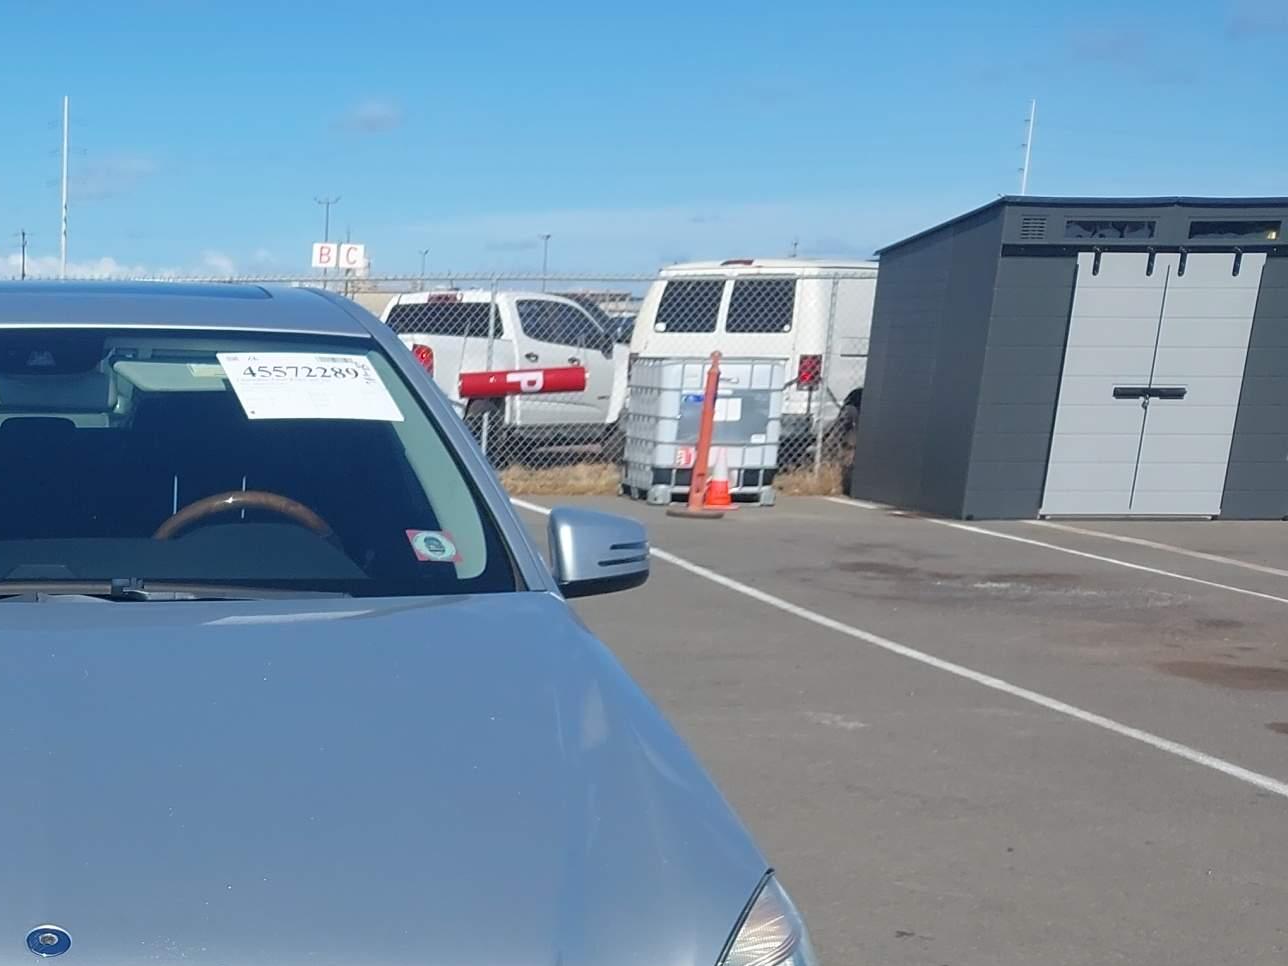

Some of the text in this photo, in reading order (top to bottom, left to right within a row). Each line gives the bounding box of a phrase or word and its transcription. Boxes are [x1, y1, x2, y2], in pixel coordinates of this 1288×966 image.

[319, 246, 331, 264] B
[346, 246, 358, 265] C
[242, 365, 360, 379] 45572289
[506, 370, 544, 392] P
